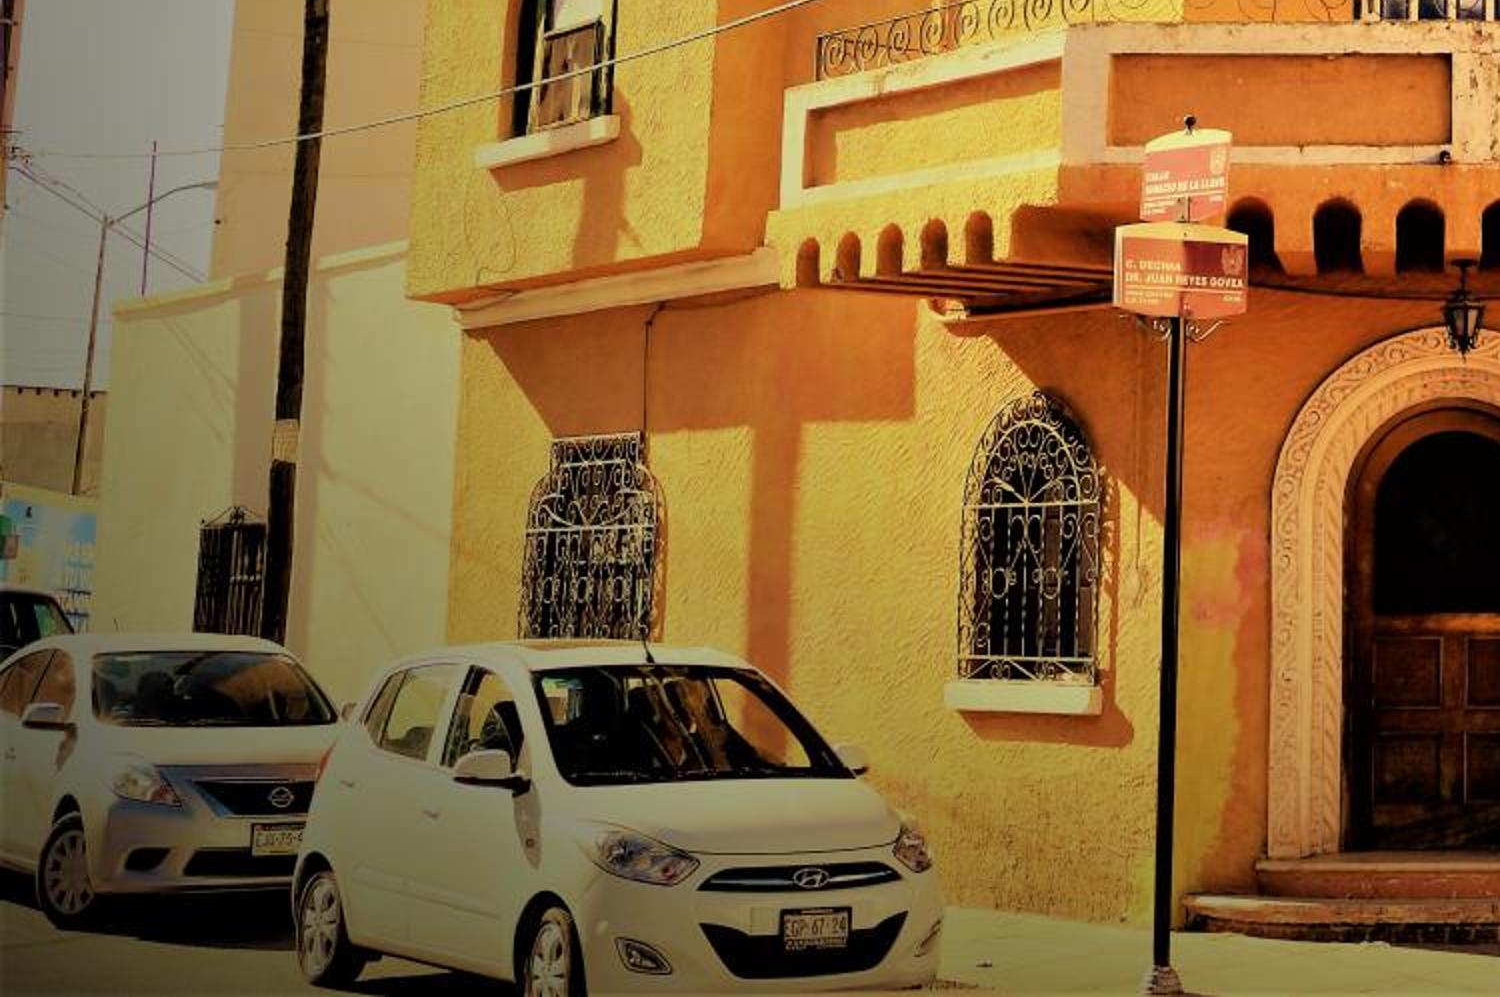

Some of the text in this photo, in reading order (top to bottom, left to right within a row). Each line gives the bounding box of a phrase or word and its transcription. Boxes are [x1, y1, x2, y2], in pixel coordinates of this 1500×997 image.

[1189, 178, 1199, 190] LA
[1146, 274, 1173, 285] JUAN
[1175, 275, 1207, 287] REYES
